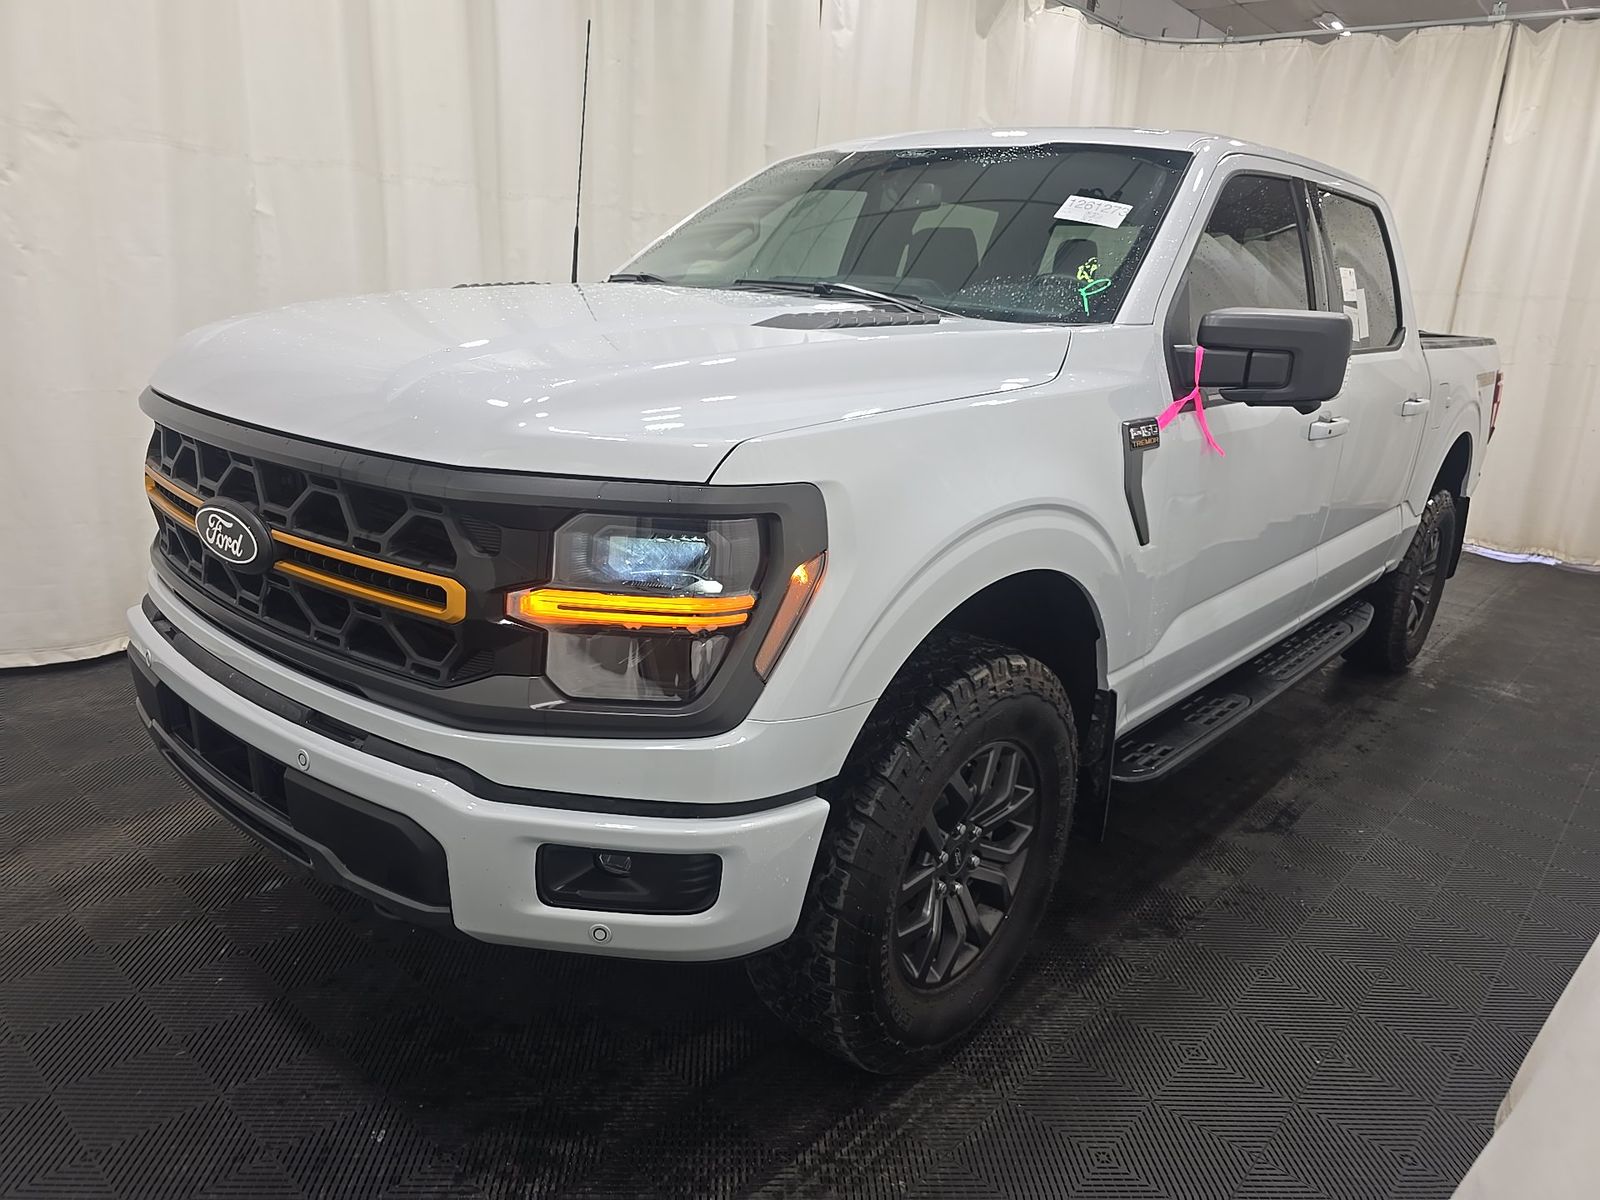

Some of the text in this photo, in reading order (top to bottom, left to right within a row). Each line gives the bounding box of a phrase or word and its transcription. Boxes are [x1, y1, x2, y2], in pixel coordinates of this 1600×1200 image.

[1068, 198, 1130, 217] 1261273
[1132, 437, 1159, 448] TREMOR
[205, 513, 245, 558] Ford
